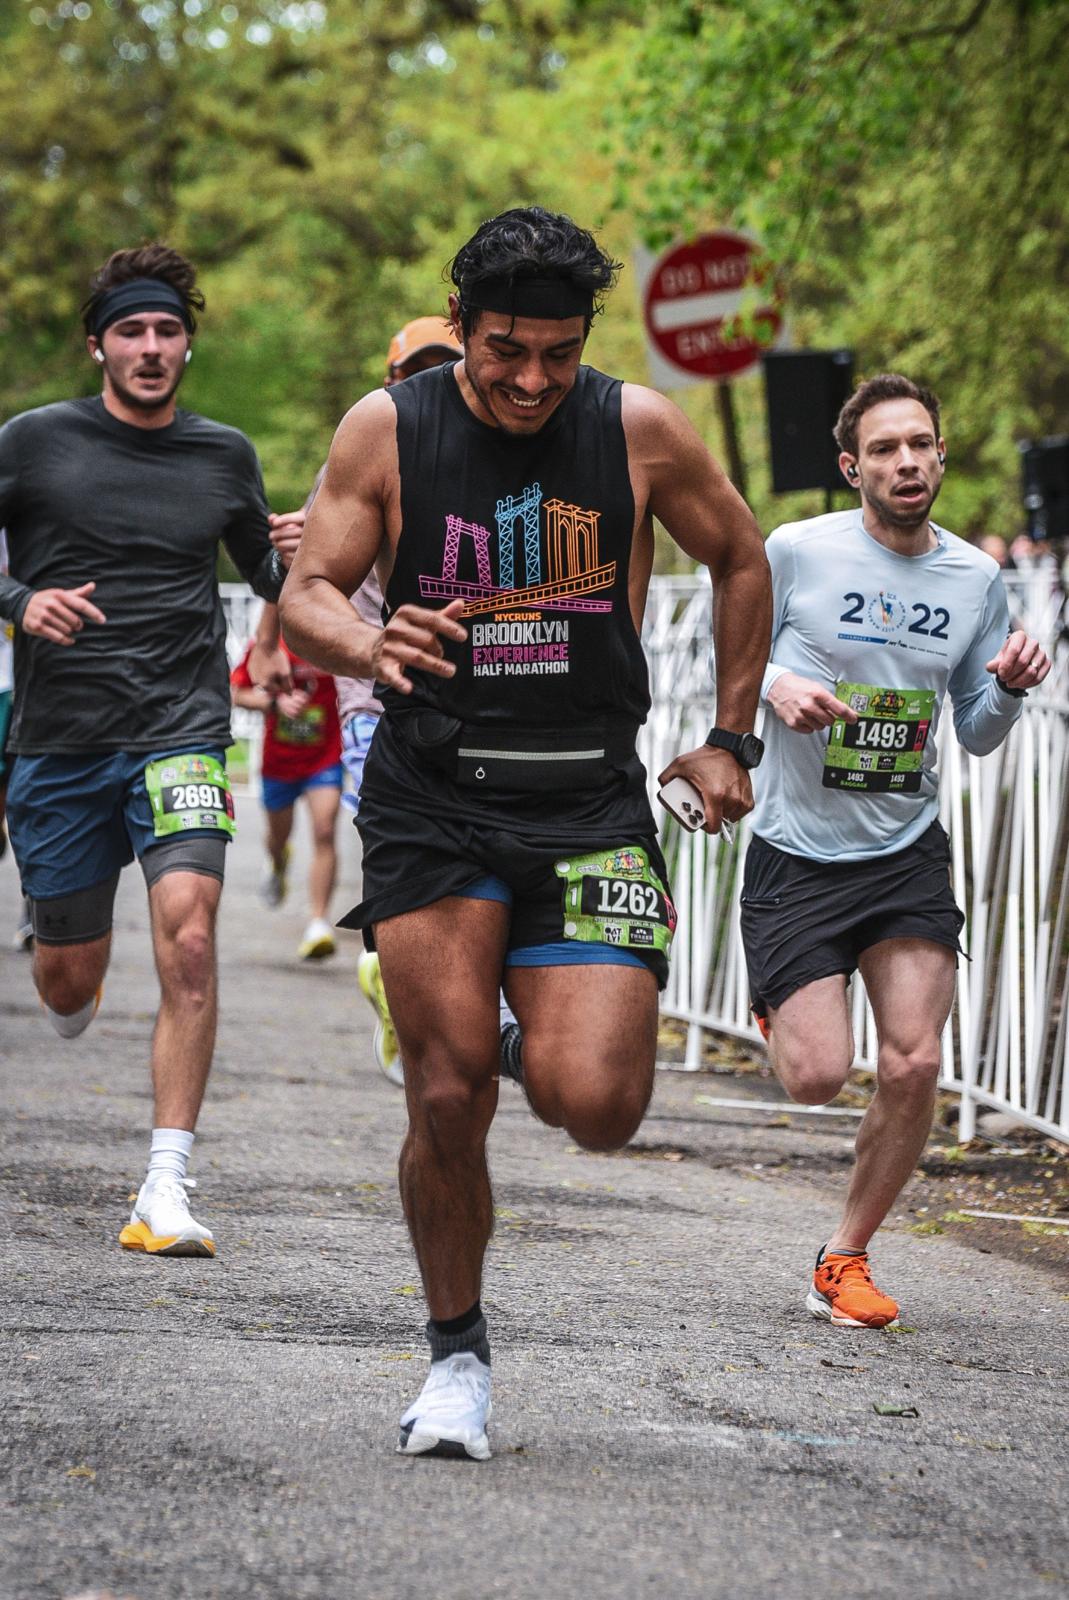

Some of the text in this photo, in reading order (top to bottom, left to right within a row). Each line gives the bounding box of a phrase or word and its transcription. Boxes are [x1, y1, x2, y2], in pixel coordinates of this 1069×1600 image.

[661, 263, 702, 297] DO
[494, 612, 542, 622] NYCRUNS
[472, 620, 569, 646] BROOKLYN
[473, 643, 569, 665] EXPERIENCE
[473, 661, 569, 677] HALF MARATHON
[835, 725, 842, 739] 1
[855, 721, 909, 749] 1493
[172, 784, 224, 810] 2691
[570, 887, 578, 907] 1
[597, 880, 660, 918] 1262
